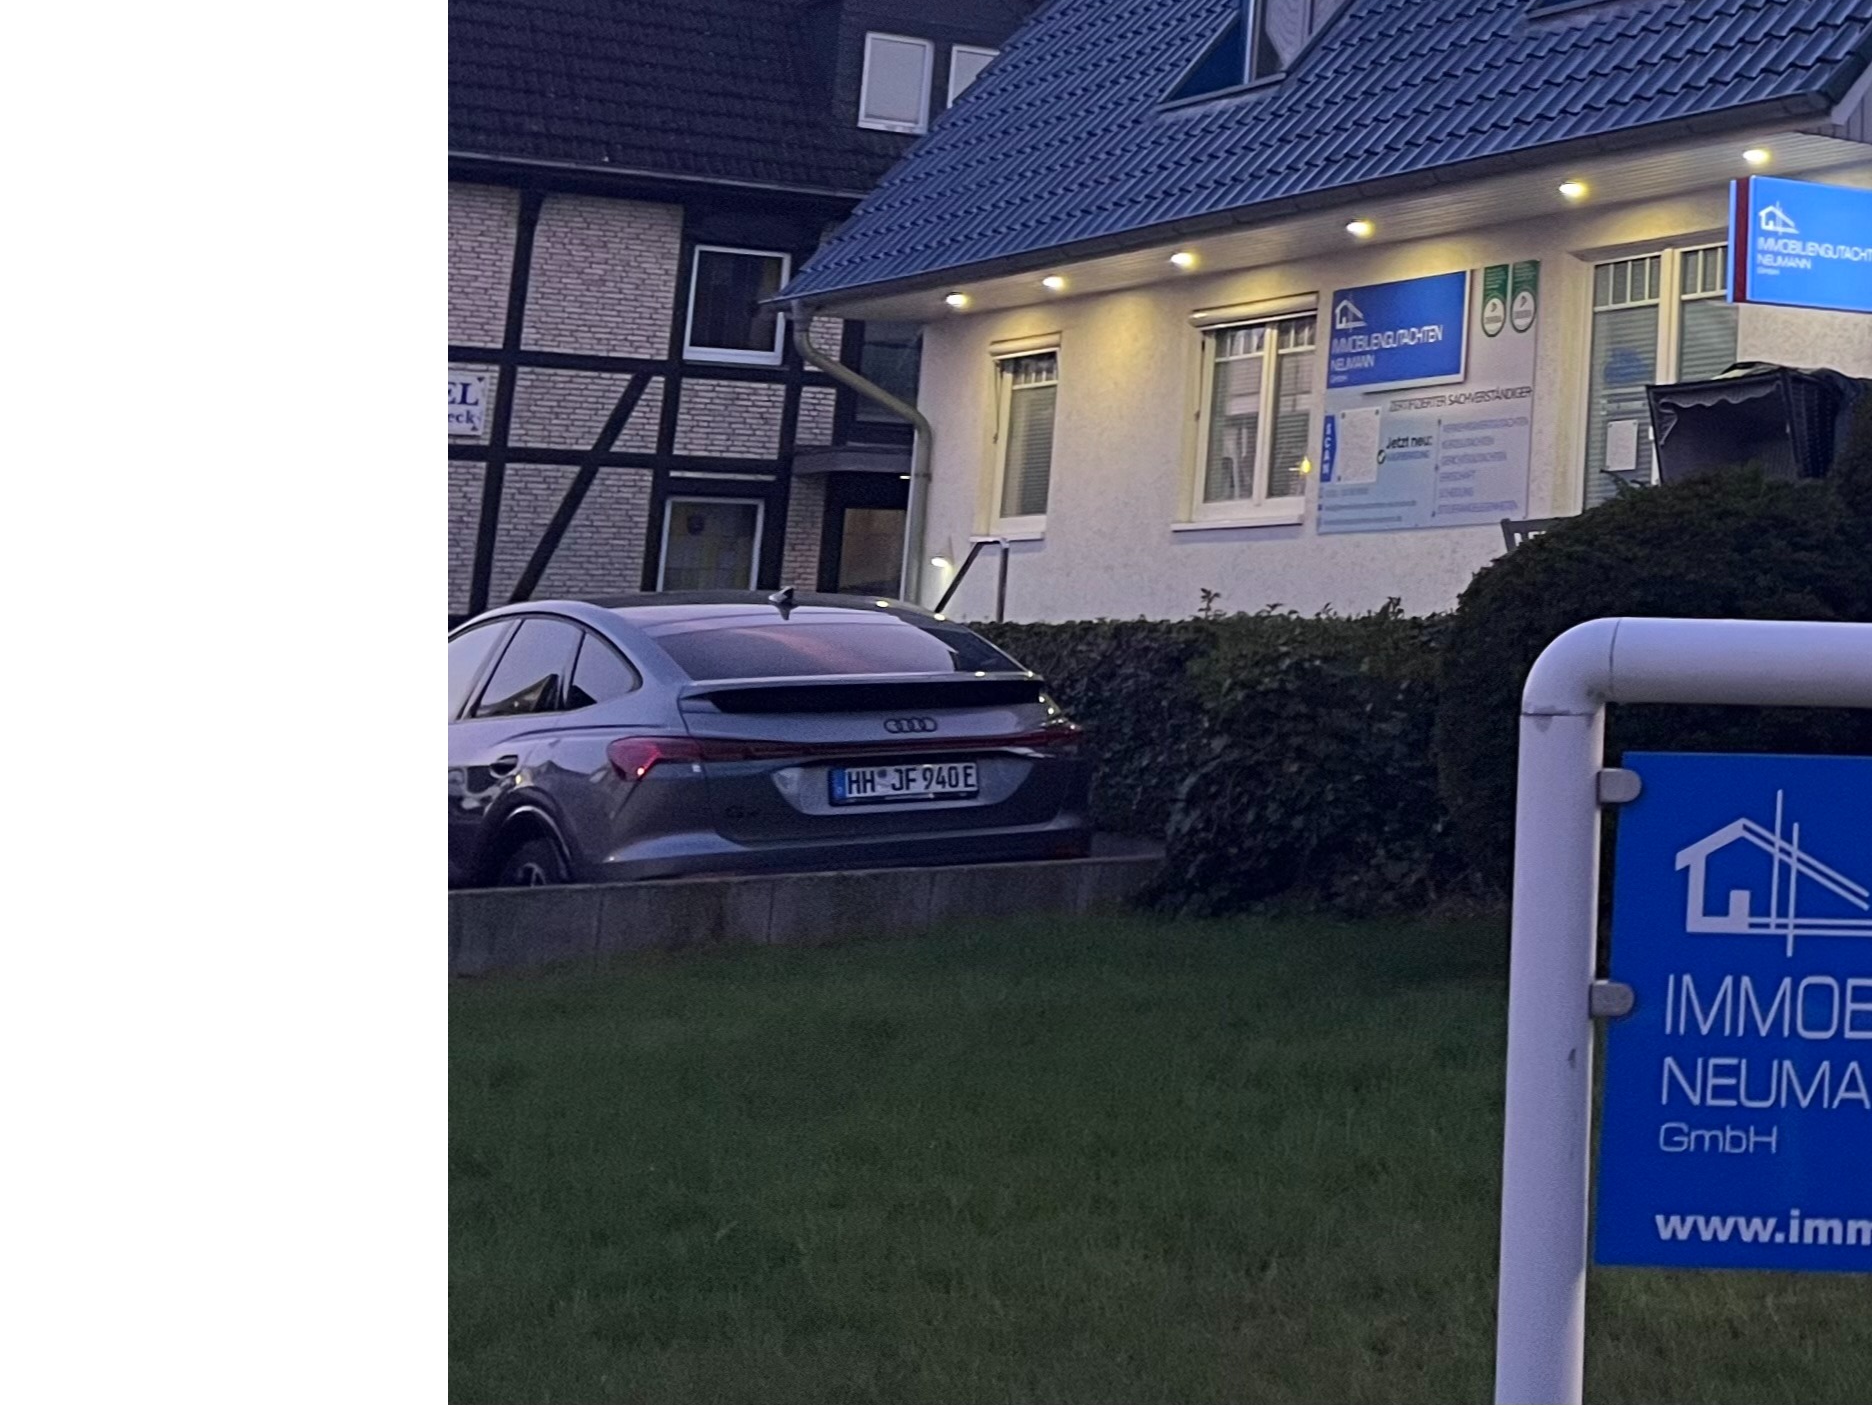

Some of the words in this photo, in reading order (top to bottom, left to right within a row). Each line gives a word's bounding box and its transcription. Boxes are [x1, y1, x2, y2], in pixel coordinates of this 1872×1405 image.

[1757, 253, 1812, 269] NEUMANN
[1386, 436, 1409, 449] Jetzt
[848, 770, 875, 795] HH
[891, 767, 917, 791] JF
[1659, 1121, 1778, 1154] GmbH
